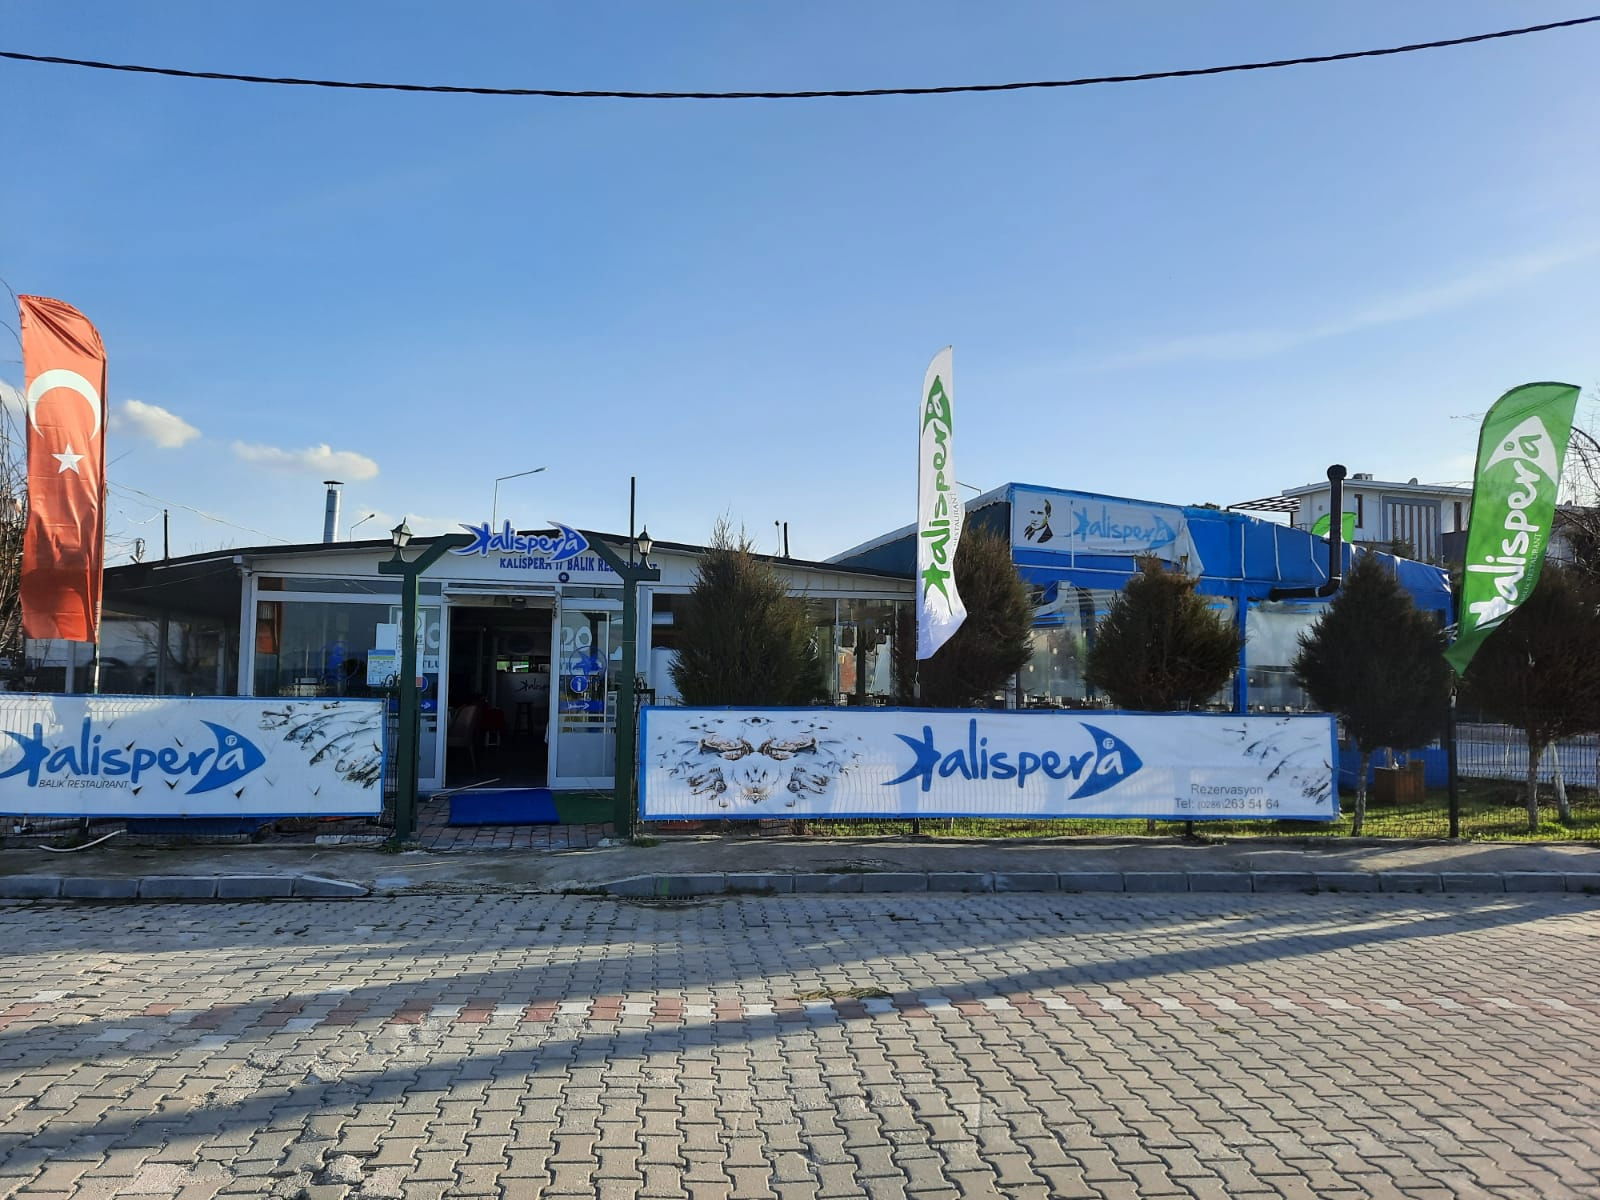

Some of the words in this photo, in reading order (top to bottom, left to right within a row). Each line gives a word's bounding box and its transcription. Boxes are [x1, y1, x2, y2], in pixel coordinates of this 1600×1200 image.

[567, 557, 594, 571] BALIK
[38, 779, 65, 788] BALIK
[67, 779, 129, 789] RESTAURANT
[1191, 784, 1264, 797] Rezervasyon
[1174, 798, 1194, 809] Tel:
[1249, 799, 1261, 809] 54
[1265, 799, 1279, 809] 64
